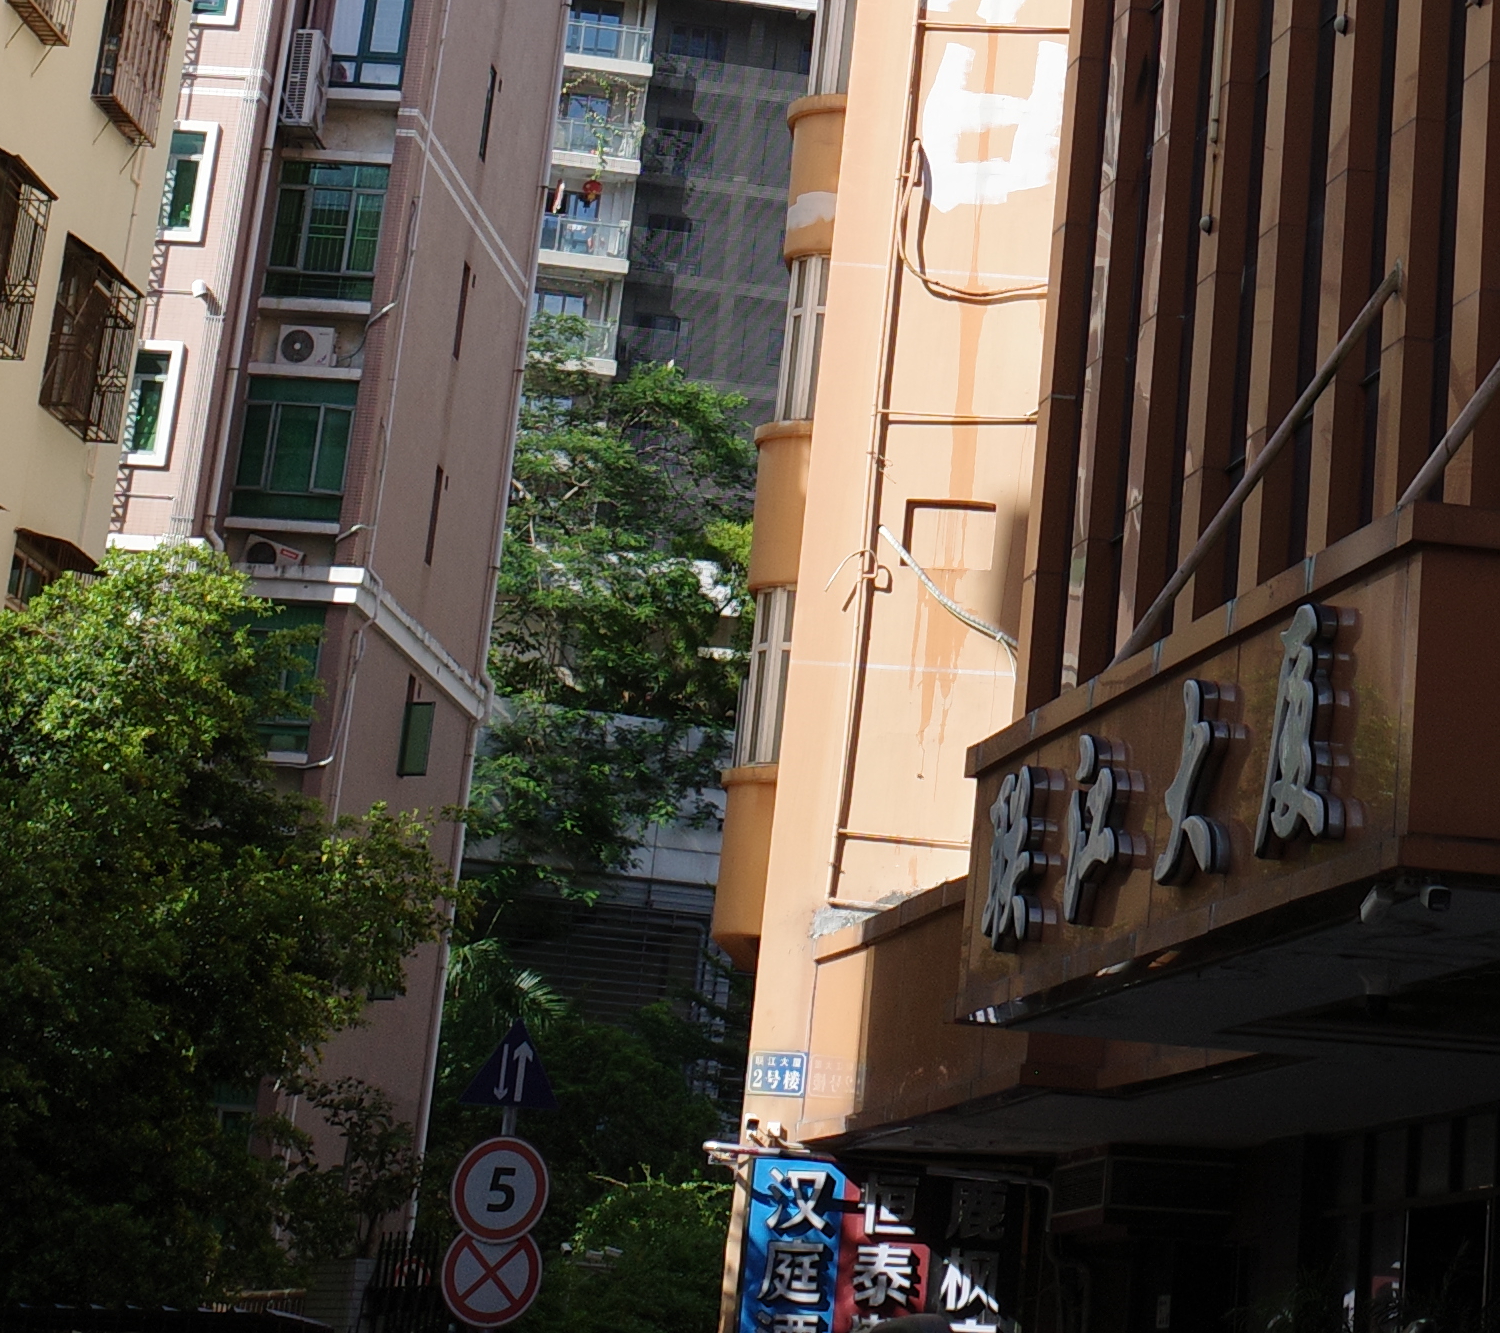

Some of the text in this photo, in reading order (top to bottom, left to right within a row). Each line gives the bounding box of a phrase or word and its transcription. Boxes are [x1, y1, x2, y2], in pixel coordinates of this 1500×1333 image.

[752, 1068, 801, 1091] 2号楼
[486, 1167, 516, 1212] 5
[852, 1168, 920, 1333] 恒泰
